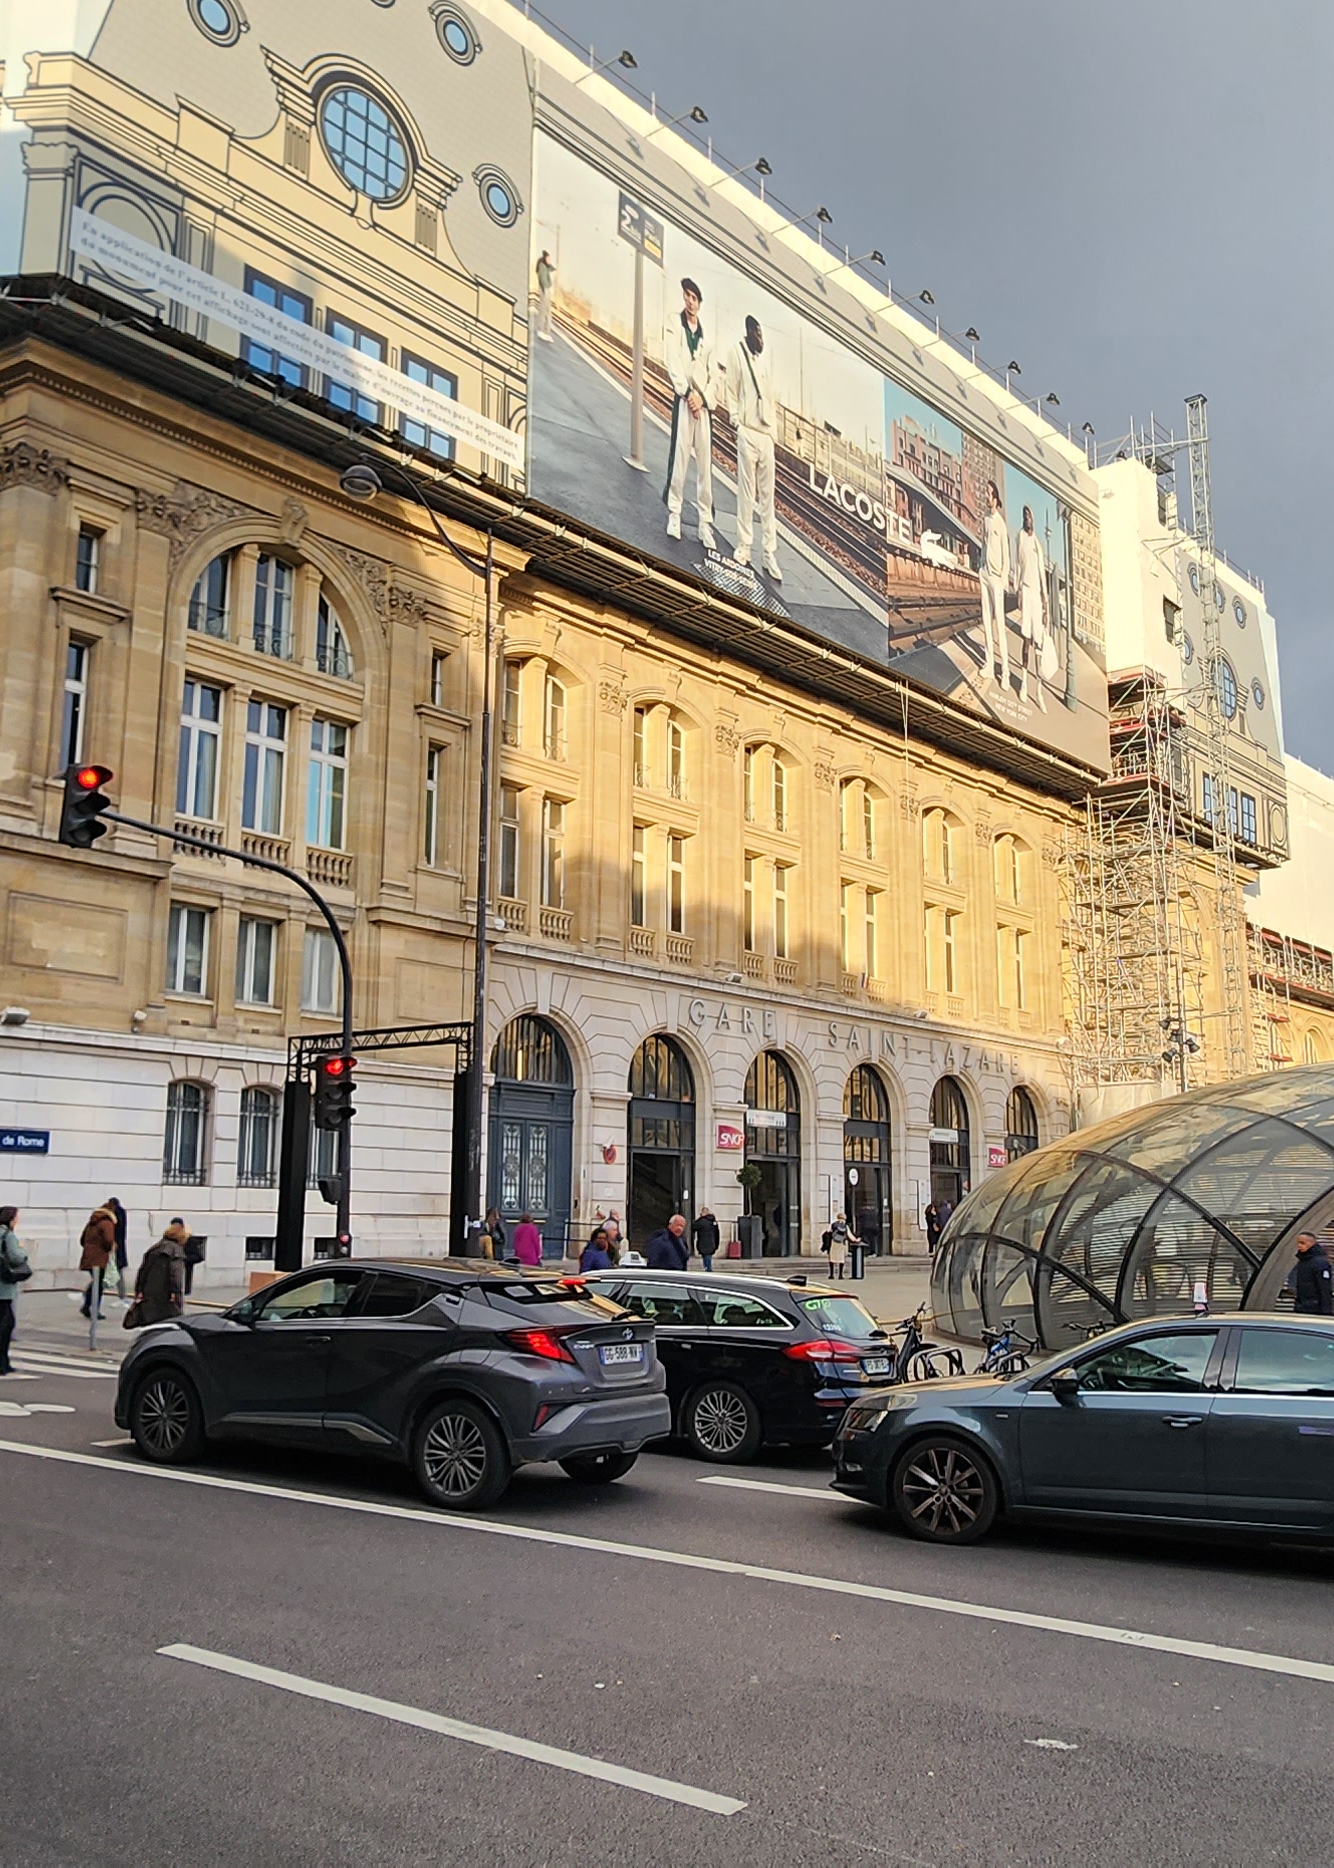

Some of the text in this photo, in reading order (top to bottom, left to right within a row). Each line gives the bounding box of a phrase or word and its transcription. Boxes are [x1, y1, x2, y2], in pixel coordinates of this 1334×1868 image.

[809, 462, 913, 545] LACOSTE
[689, 999, 776, 1039] GARE
[2, 1135, 15, 1145] de
[17, 1136, 45, 1147] Rome
[720, 1133, 745, 1145] SNCF
